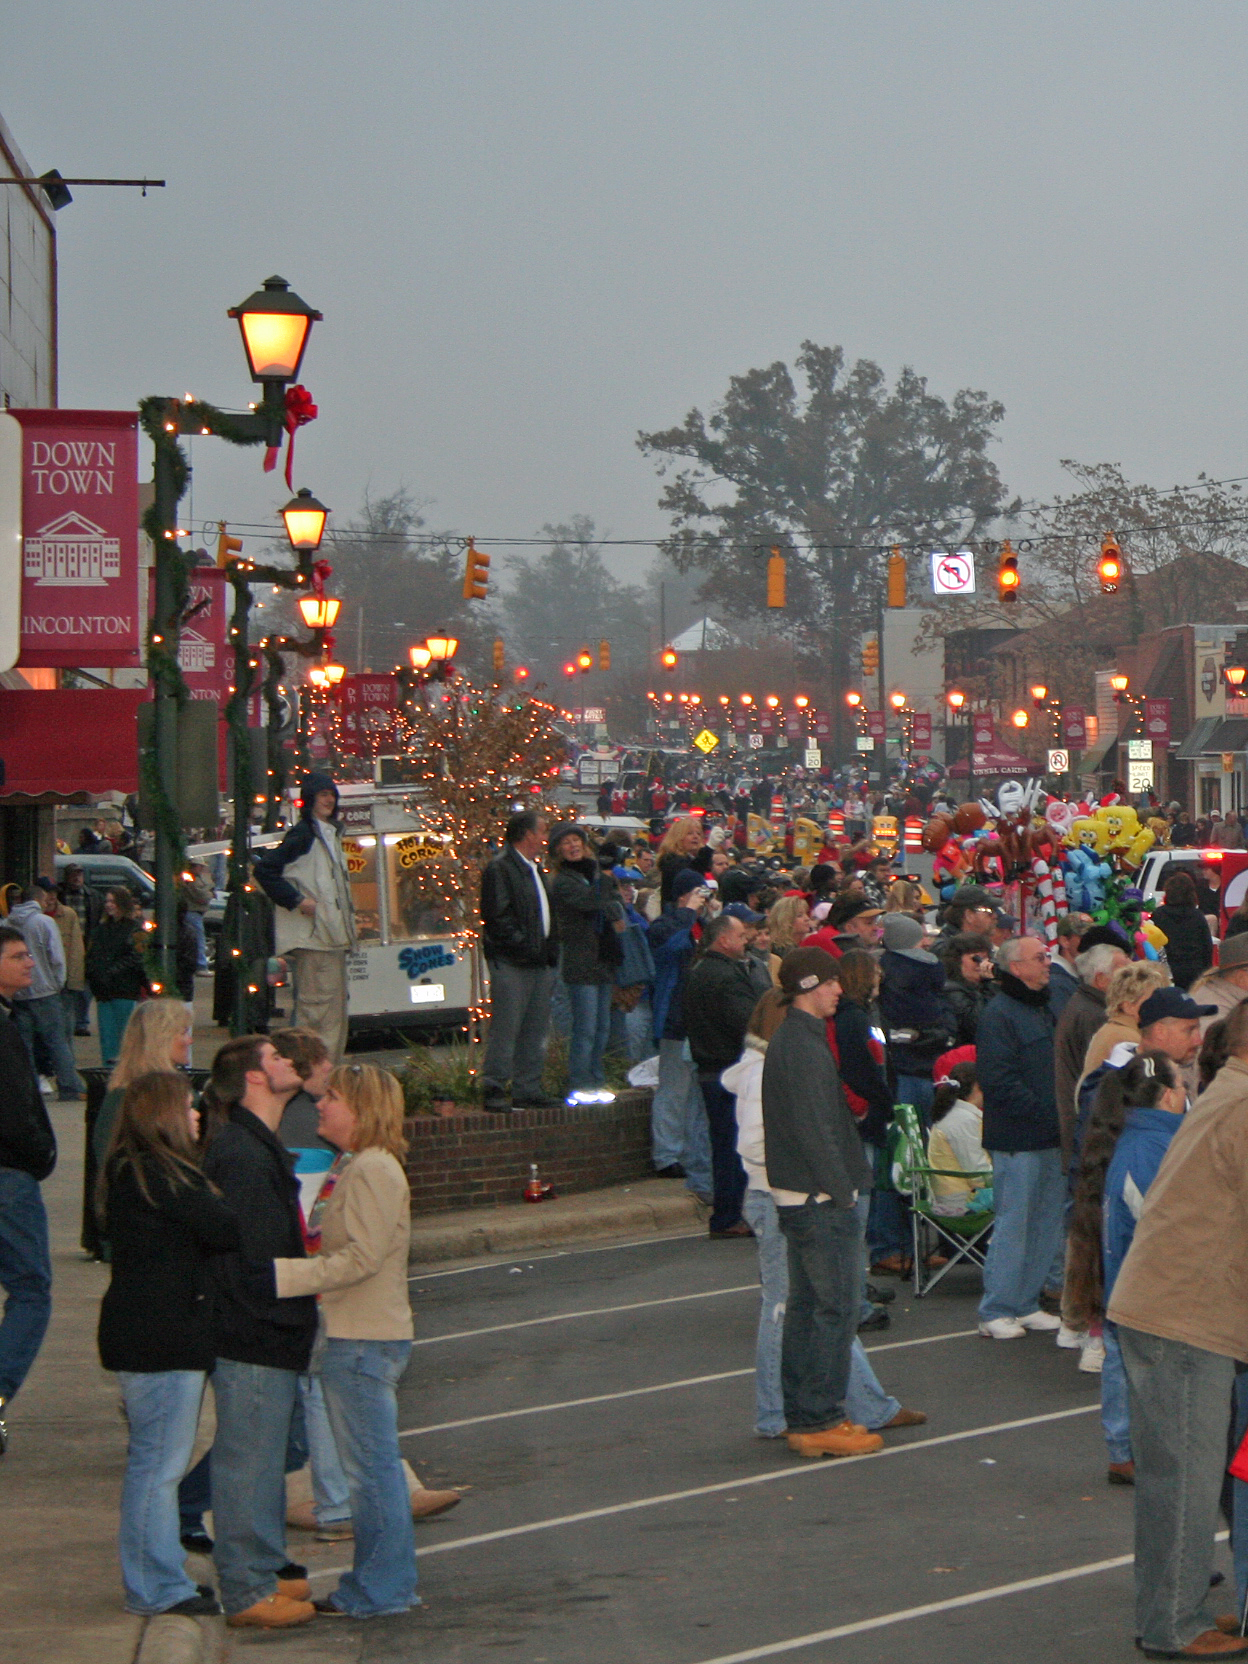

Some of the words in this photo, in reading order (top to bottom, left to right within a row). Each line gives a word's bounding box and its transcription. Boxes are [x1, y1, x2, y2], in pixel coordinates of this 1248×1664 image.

[32, 441, 116, 467] DOWN
[31, 469, 115, 495] TOWN
[362, 684, 391, 693] DOWN
[362, 692, 390, 702] TOWN
[1133, 778, 1150, 789] 20
[347, 811, 370, 821] CORN
[398, 944, 444, 970] SNOW
[407, 953, 456, 980] CONES
